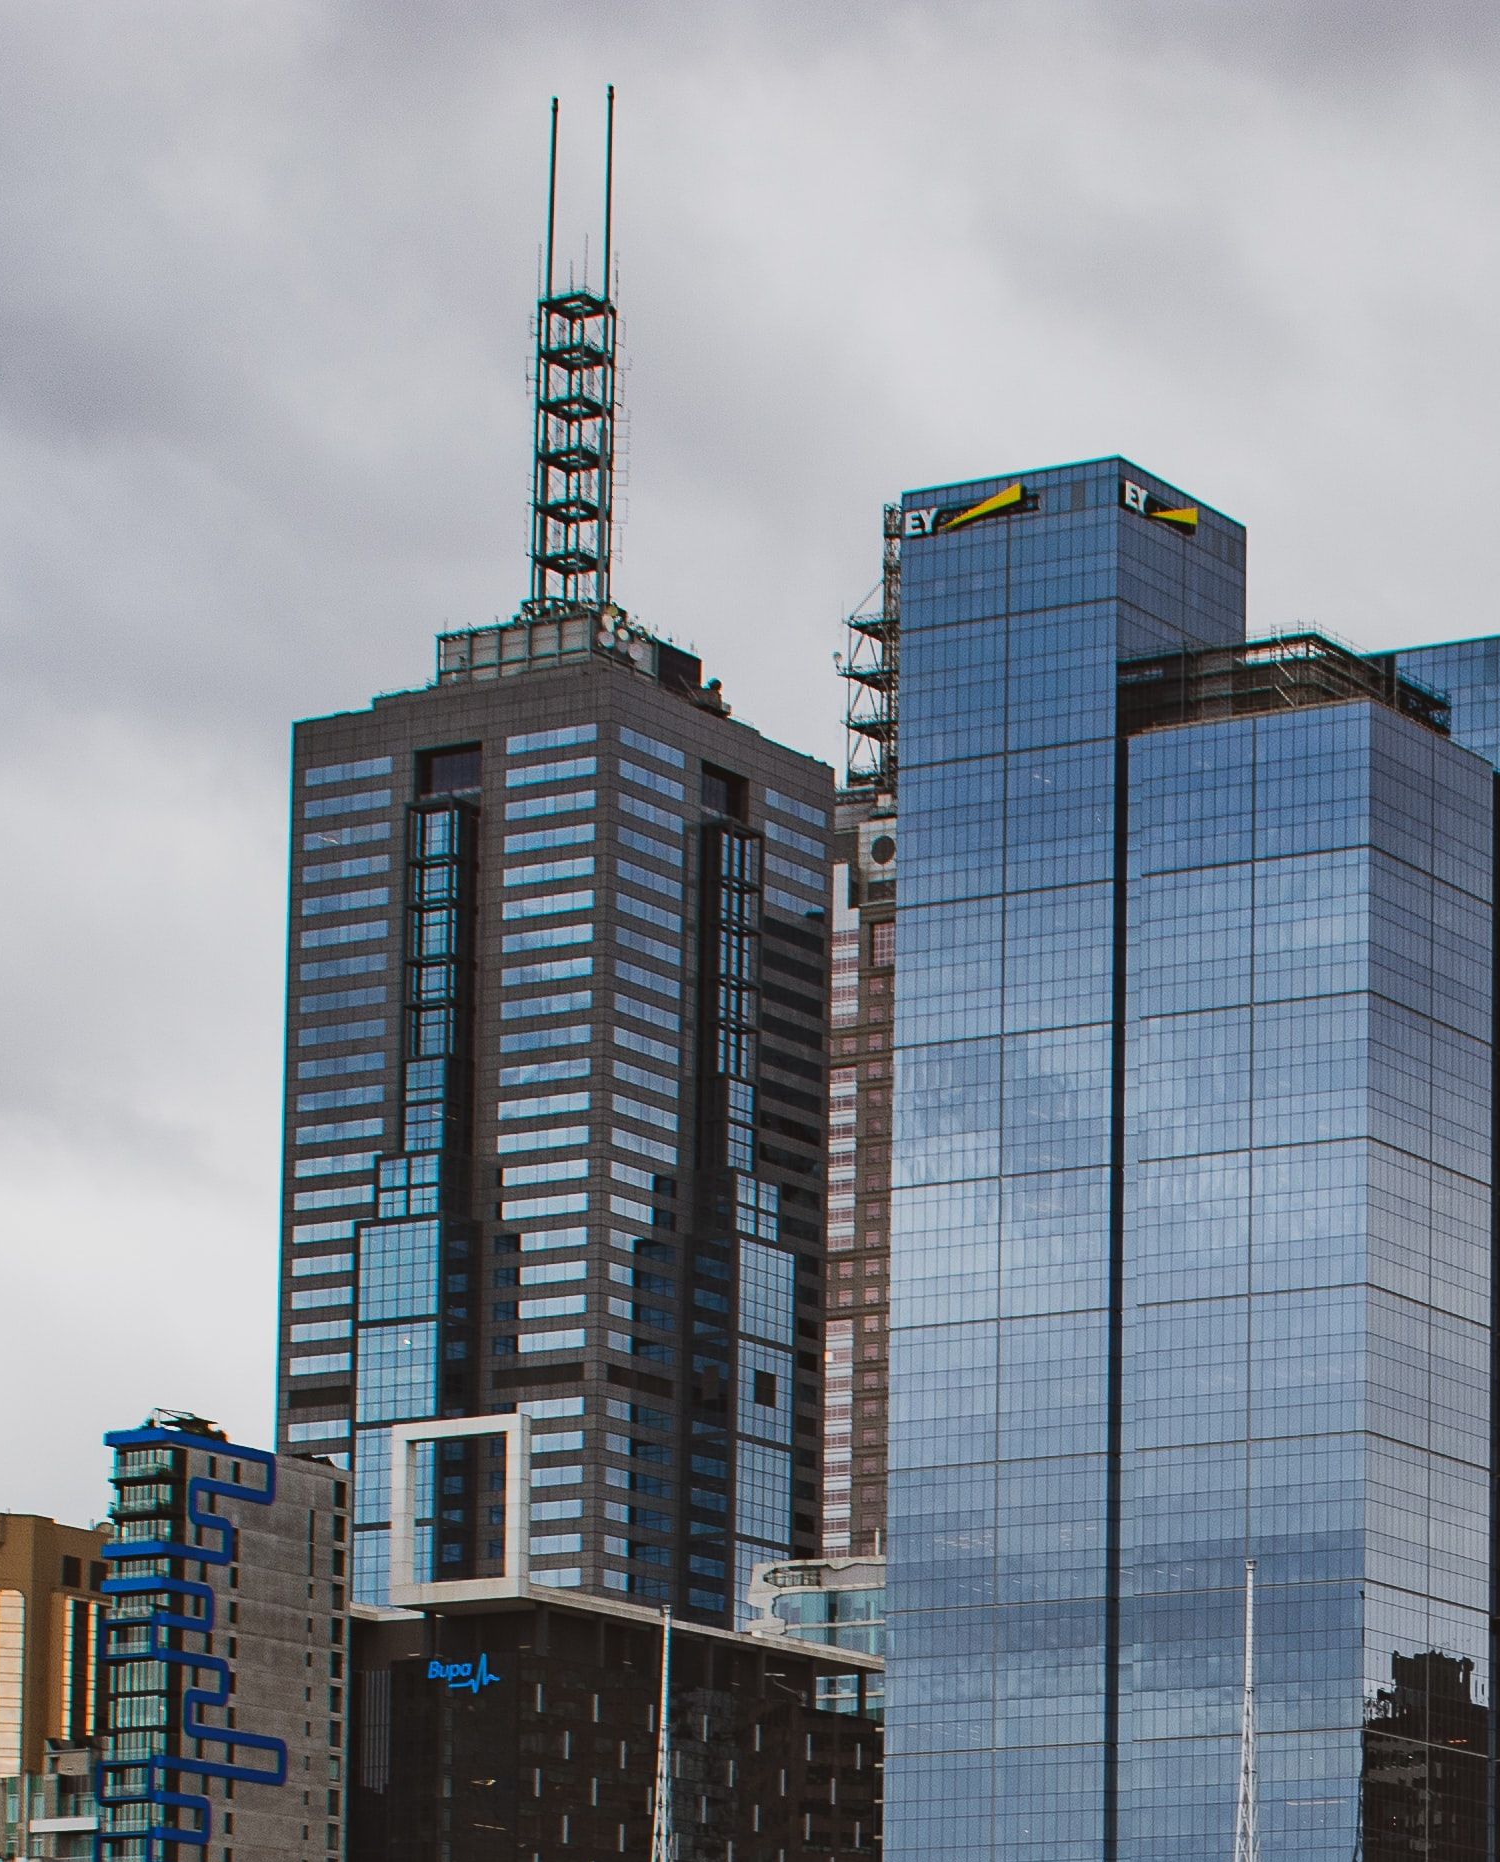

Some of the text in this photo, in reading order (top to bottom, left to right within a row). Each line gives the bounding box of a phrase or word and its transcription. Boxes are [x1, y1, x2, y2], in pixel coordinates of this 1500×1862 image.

[1124, 480, 1149, 514] EY
[904, 508, 939, 538] EY
[428, 1661, 473, 1681] Bupa
